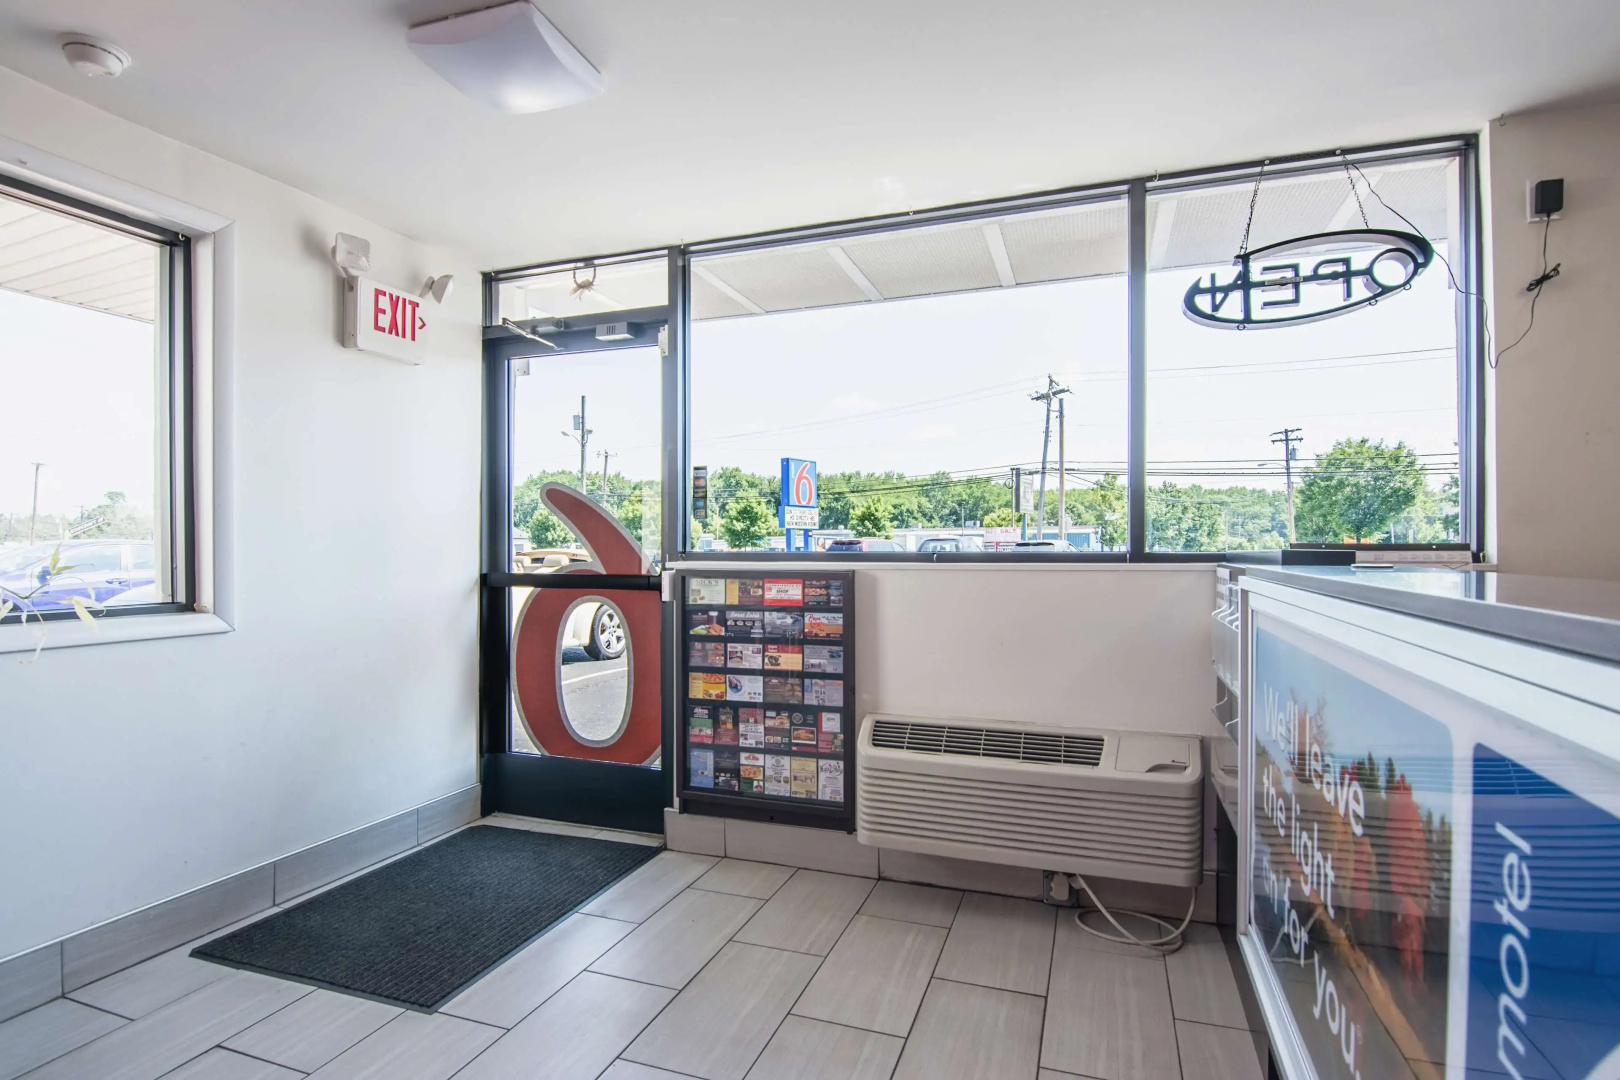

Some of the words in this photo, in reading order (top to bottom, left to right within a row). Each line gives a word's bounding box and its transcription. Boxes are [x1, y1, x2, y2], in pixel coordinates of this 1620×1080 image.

[373, 287, 420, 342] EXIT
[793, 461, 814, 505] 6
[1264, 686, 1299, 770] We'll
[1304, 713, 1365, 837] leave
[1262, 770, 1286, 837] the
[1290, 794, 1335, 919] light
[1262, 856, 1279, 914] on
[1284, 877, 1310, 967] for
[1495, 821, 1532, 1080] motel
